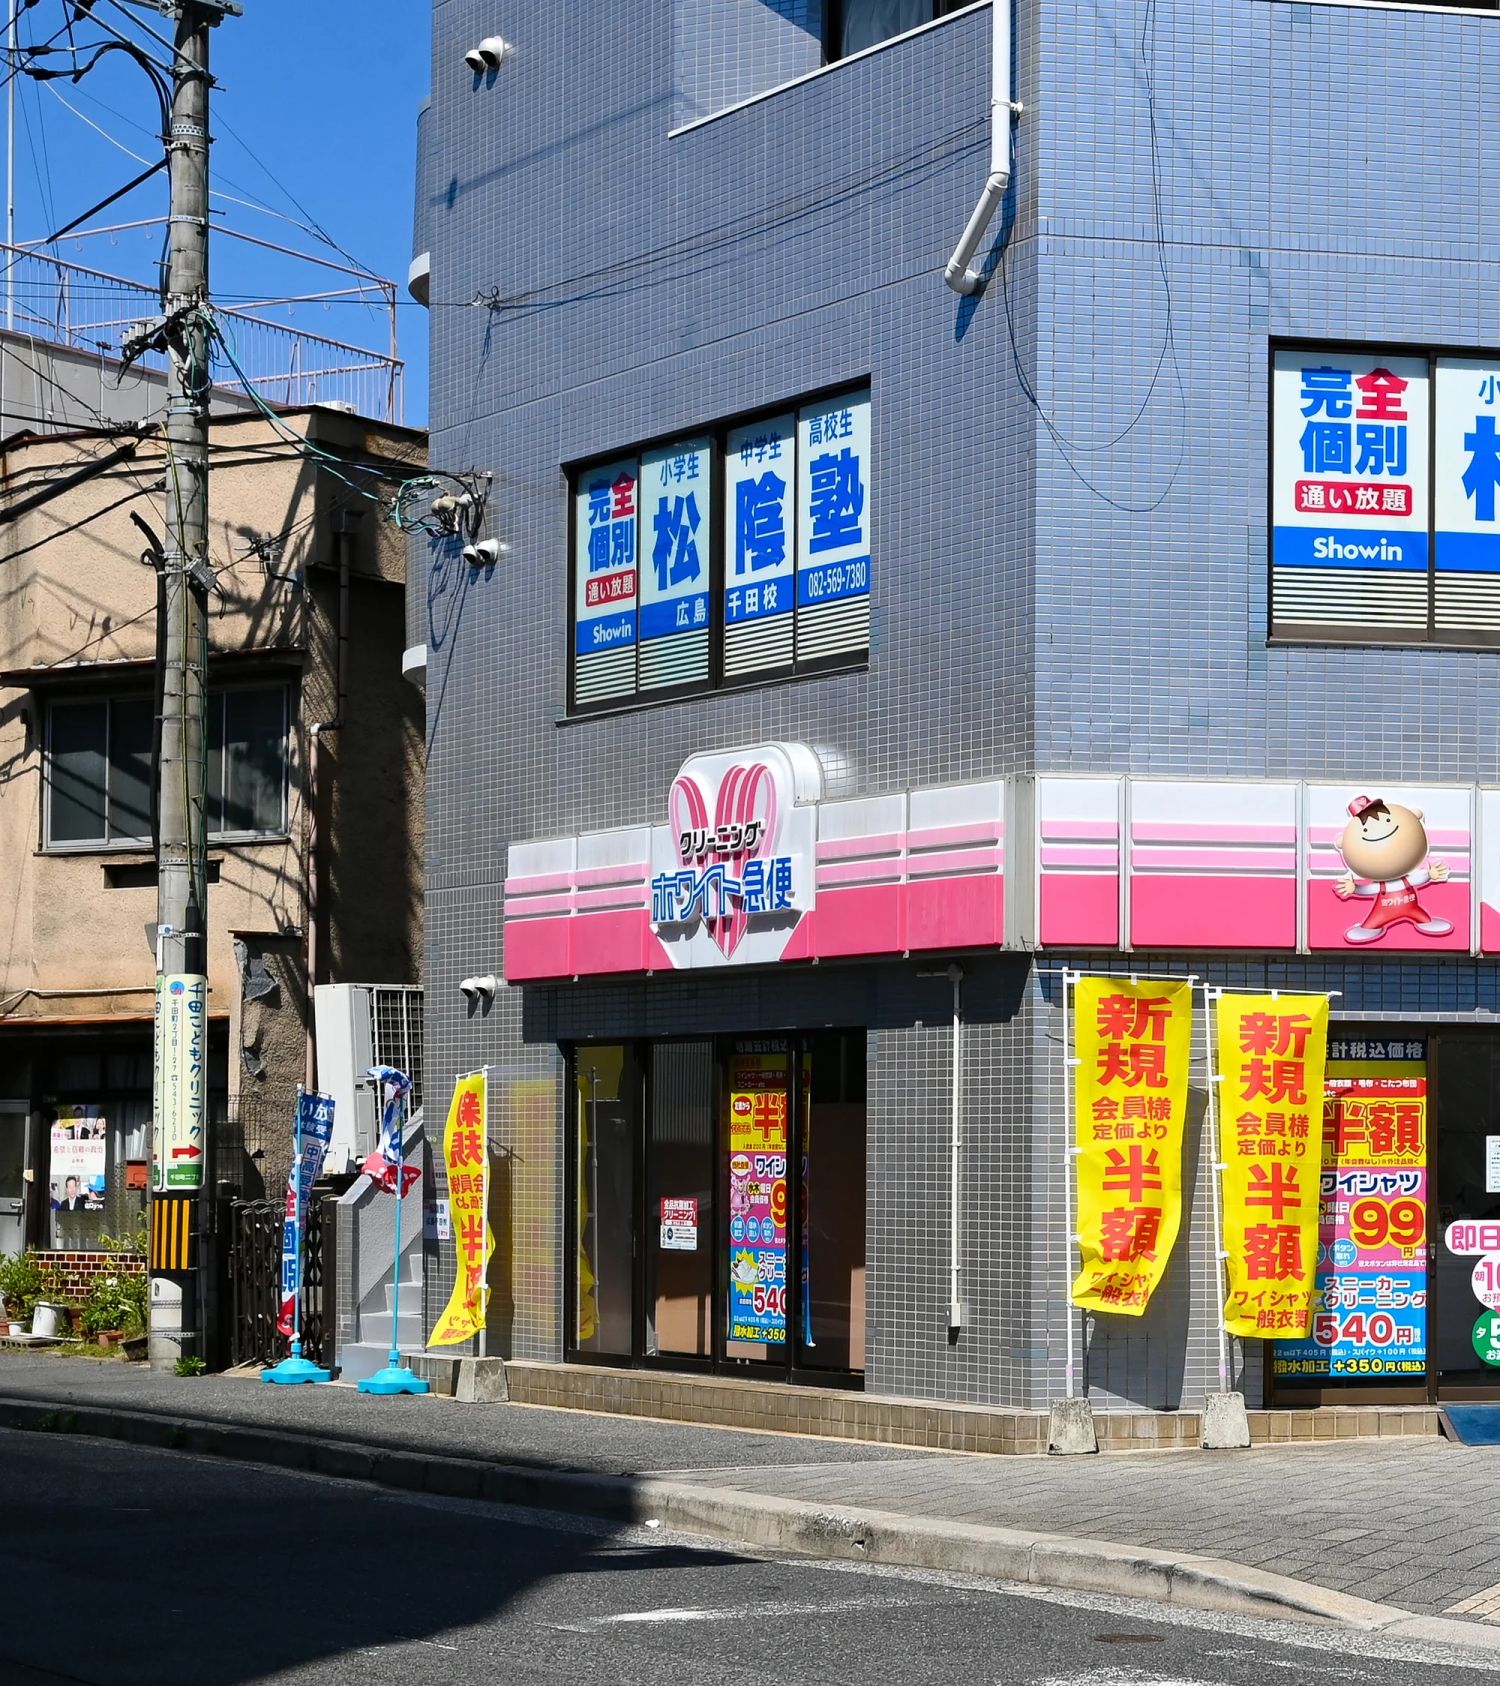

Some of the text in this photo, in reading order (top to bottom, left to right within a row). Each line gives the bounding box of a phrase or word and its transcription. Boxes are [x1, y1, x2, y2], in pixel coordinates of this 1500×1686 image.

[1300, 367, 1409, 421] 完全
[808, 410, 852, 447] 高校生
[740, 432, 781, 467] 中学生
[1299, 424, 1407, 477] 個別
[660, 454, 699, 486] 小学生
[588, 471, 636, 523] 完全
[1300, 485, 1407, 512] 通い放題
[652, 447, 864, 591] 松 陰 塾
[588, 519, 634, 572] 個別
[1312, 536, 1403, 561] Showin
[587, 573, 634, 601] 通い放題
[808, 564, 866, 597] 082-569-7380
[676, 583, 778, 626] 広島 千田校
[593, 618, 632, 644] Showin
[680, 822, 762, 856] クリーニング
[652, 857, 792, 922] ホワイト急便
[1096, 994, 1173, 1088] 新規
[1326, 1042, 1423, 1059] 計税込価格
[1239, 1012, 1313, 1105] 新規
[1091, 1096, 1171, 1121] 会員様
[1236, 1112, 1310, 1138] 会員様
[1093, 1123, 1168, 1141] 定価より
[1237, 1140, 1306, 1157] 定価より
[1099, 1145, 1163, 1263] 半額
[1243, 1163, 1306, 1282] 半額
[1353, 1201, 1425, 1246] 99
[1326, 1278, 1409, 1291] スニーカー
[1474, 1271, 1485, 1281] 朝
[1325, 1293, 1426, 1308] クリーニング
[1315, 1315, 1393, 1344] 540
[1396, 1328, 1412, 1343] 円
[1274, 1361, 1330, 1374] 撥水加工
